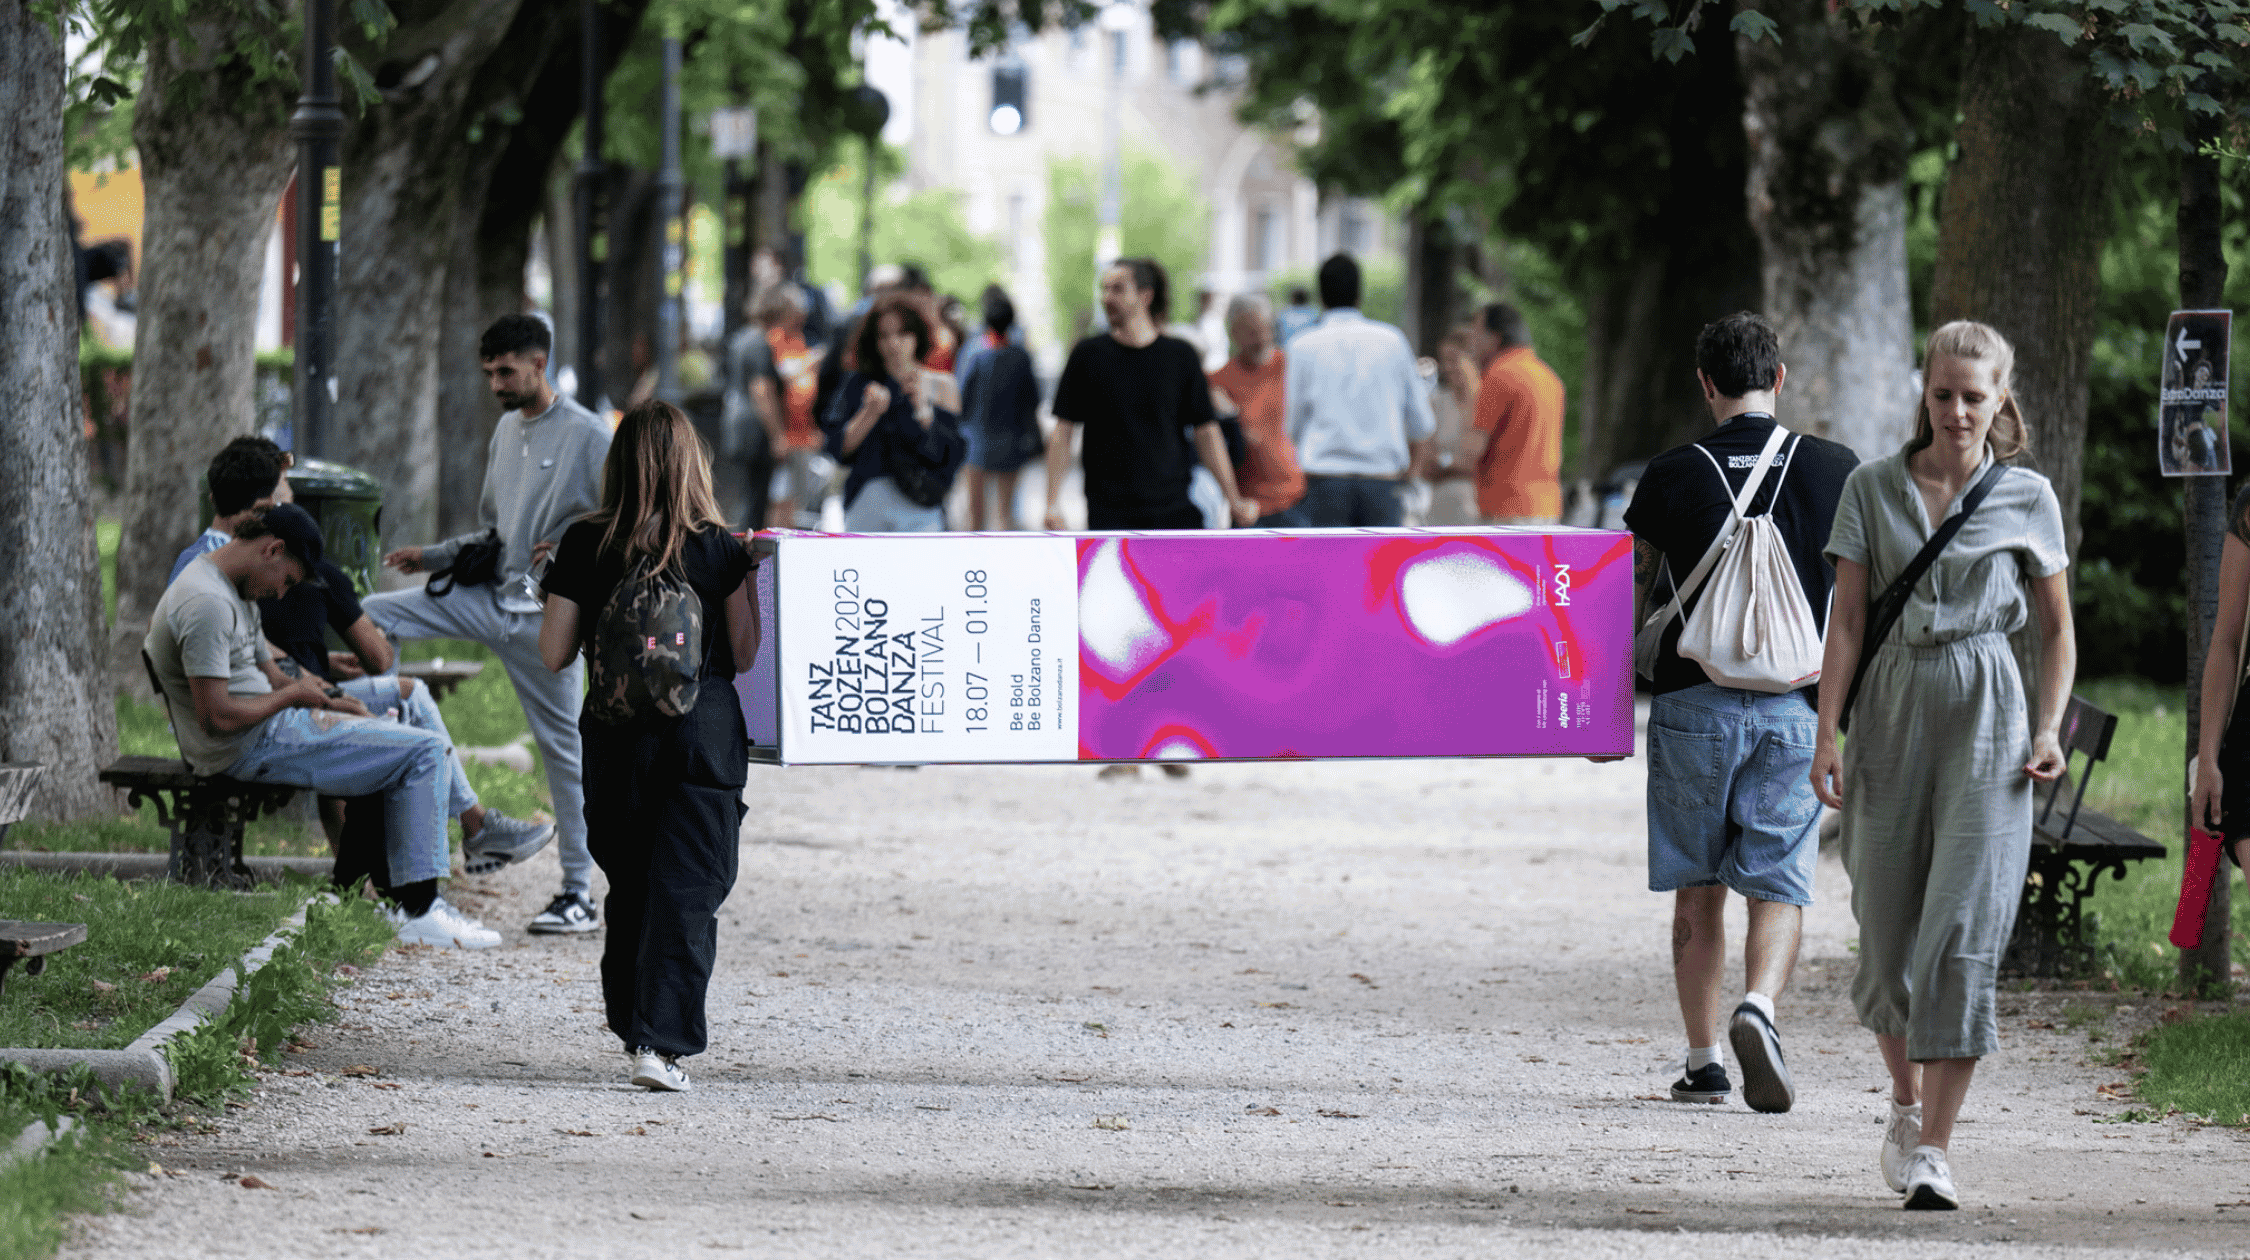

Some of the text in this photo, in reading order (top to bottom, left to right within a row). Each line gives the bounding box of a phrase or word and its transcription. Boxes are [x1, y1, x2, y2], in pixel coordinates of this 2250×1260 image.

[965, 569, 988, 635] 01.08
[834, 569, 864, 735] BOZEN 2025
[864, 597, 890, 735] BOLZANO
[891, 631, 916, 735] DANZA
[921, 605, 945, 734] FESTIVAL
[1028, 599, 1041, 731] Be Bolzano Danza
[808, 661, 835, 735] TANZ
[965, 672, 989, 734] 18.07
[1010, 674, 1024, 731] Be Bold
[1557, 692, 1571, 729] alperia
